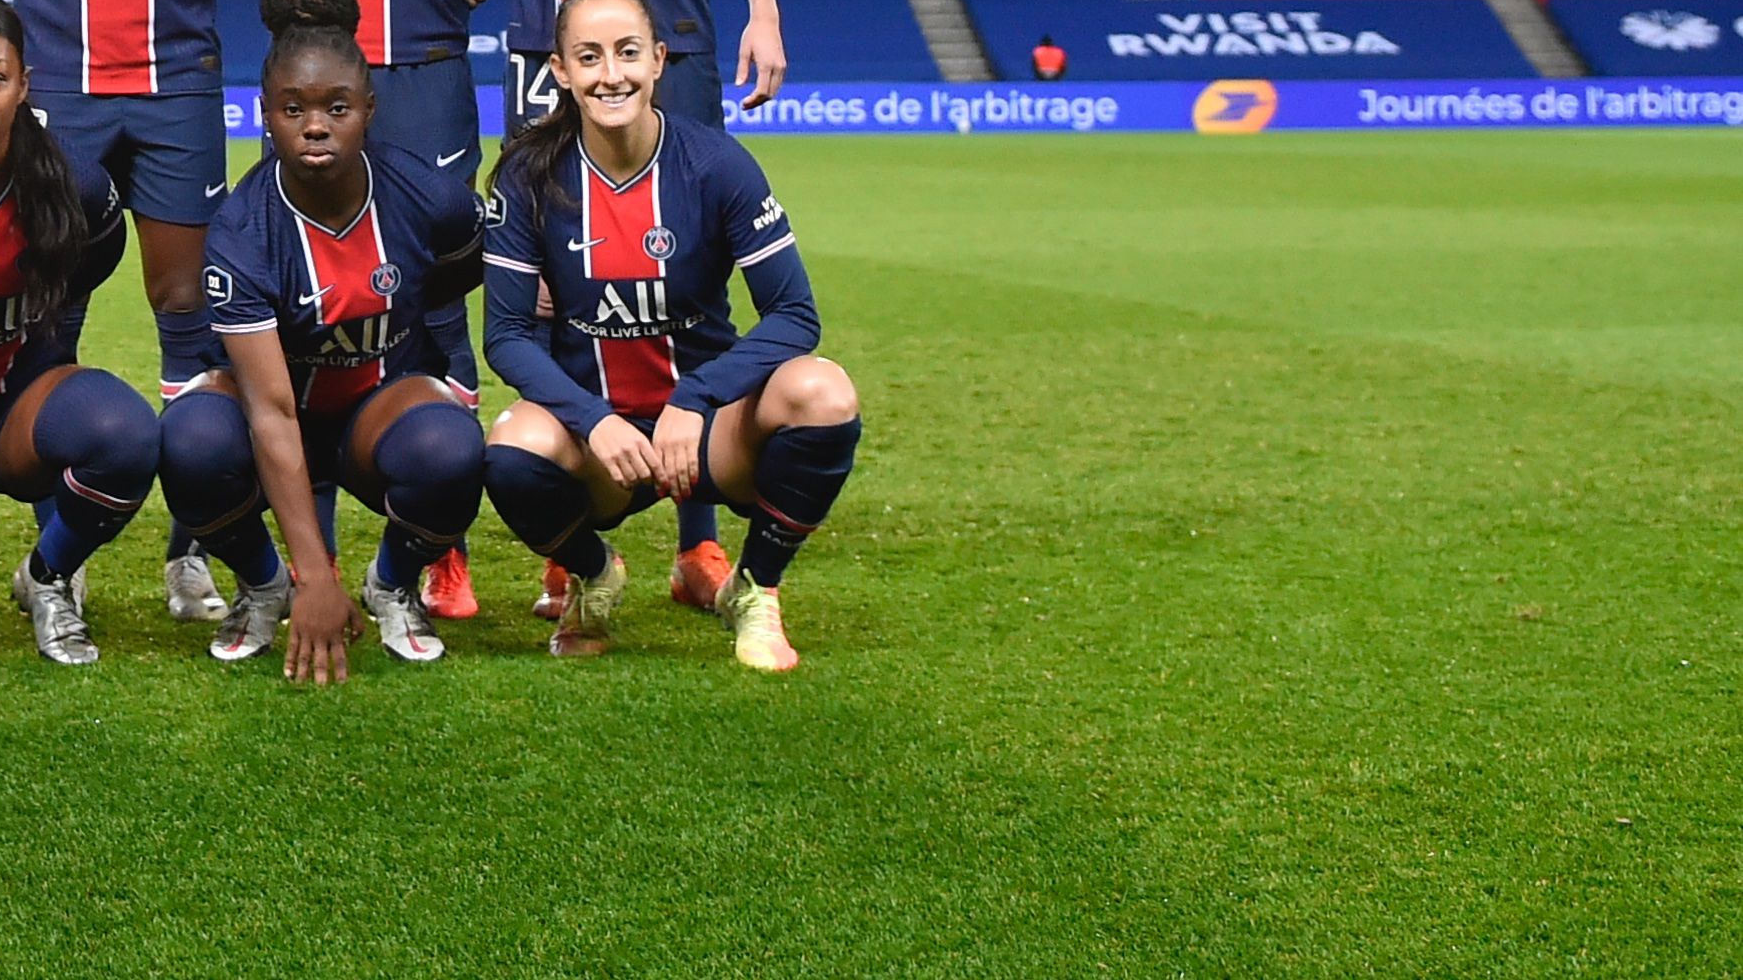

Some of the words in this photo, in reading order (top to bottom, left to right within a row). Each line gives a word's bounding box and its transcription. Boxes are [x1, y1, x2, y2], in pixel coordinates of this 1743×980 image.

[1158, 12, 1321, 33] VISIT
[1108, 31, 1401, 55] RWANDA
[510, 54, 559, 115] 14
[722, 91, 867, 124] ournées
[874, 90, 922, 122] de
[931, 90, 1118, 130] l'arbitrage
[1358, 86, 1525, 121] Journées
[1530, 86, 1579, 120] de
[1586, 84, 1743, 125] l'arbitrag
[568, 318, 608, 337] ACCOR
[610, 326, 641, 338] LIVE
[330, 357, 360, 367] LIVE
